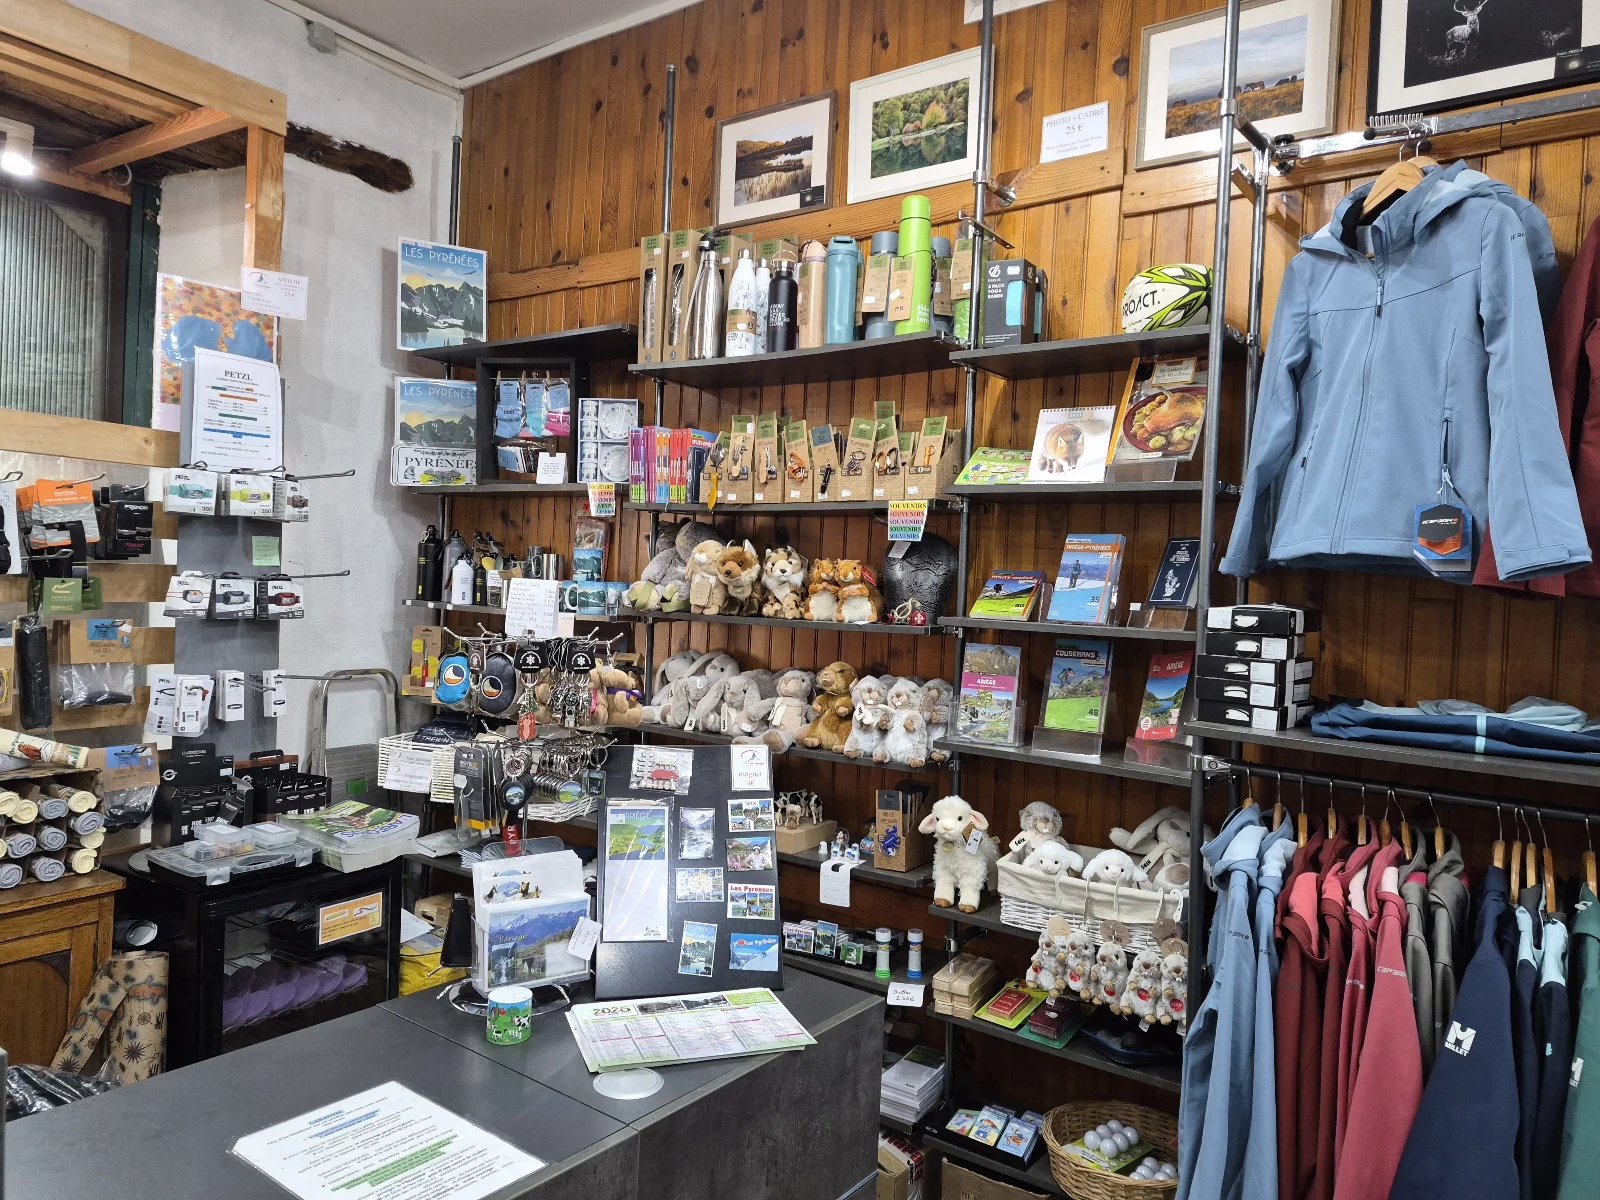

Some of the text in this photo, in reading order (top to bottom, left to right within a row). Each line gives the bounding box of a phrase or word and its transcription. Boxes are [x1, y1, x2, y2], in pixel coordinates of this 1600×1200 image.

[1046, 117, 1071, 127] PHOTO
[1078, 108, 1105, 120] CADRE
[1066, 124, 1076, 135] 25
[405, 246, 479, 268] LES PYRÉNÉES
[404, 386, 423, 397] LES
[405, 456, 477, 469] PYRÉNÉE
[1055, 649, 1096, 659] COUSERANS
[1444, 1041, 1469, 1057] MILLET
